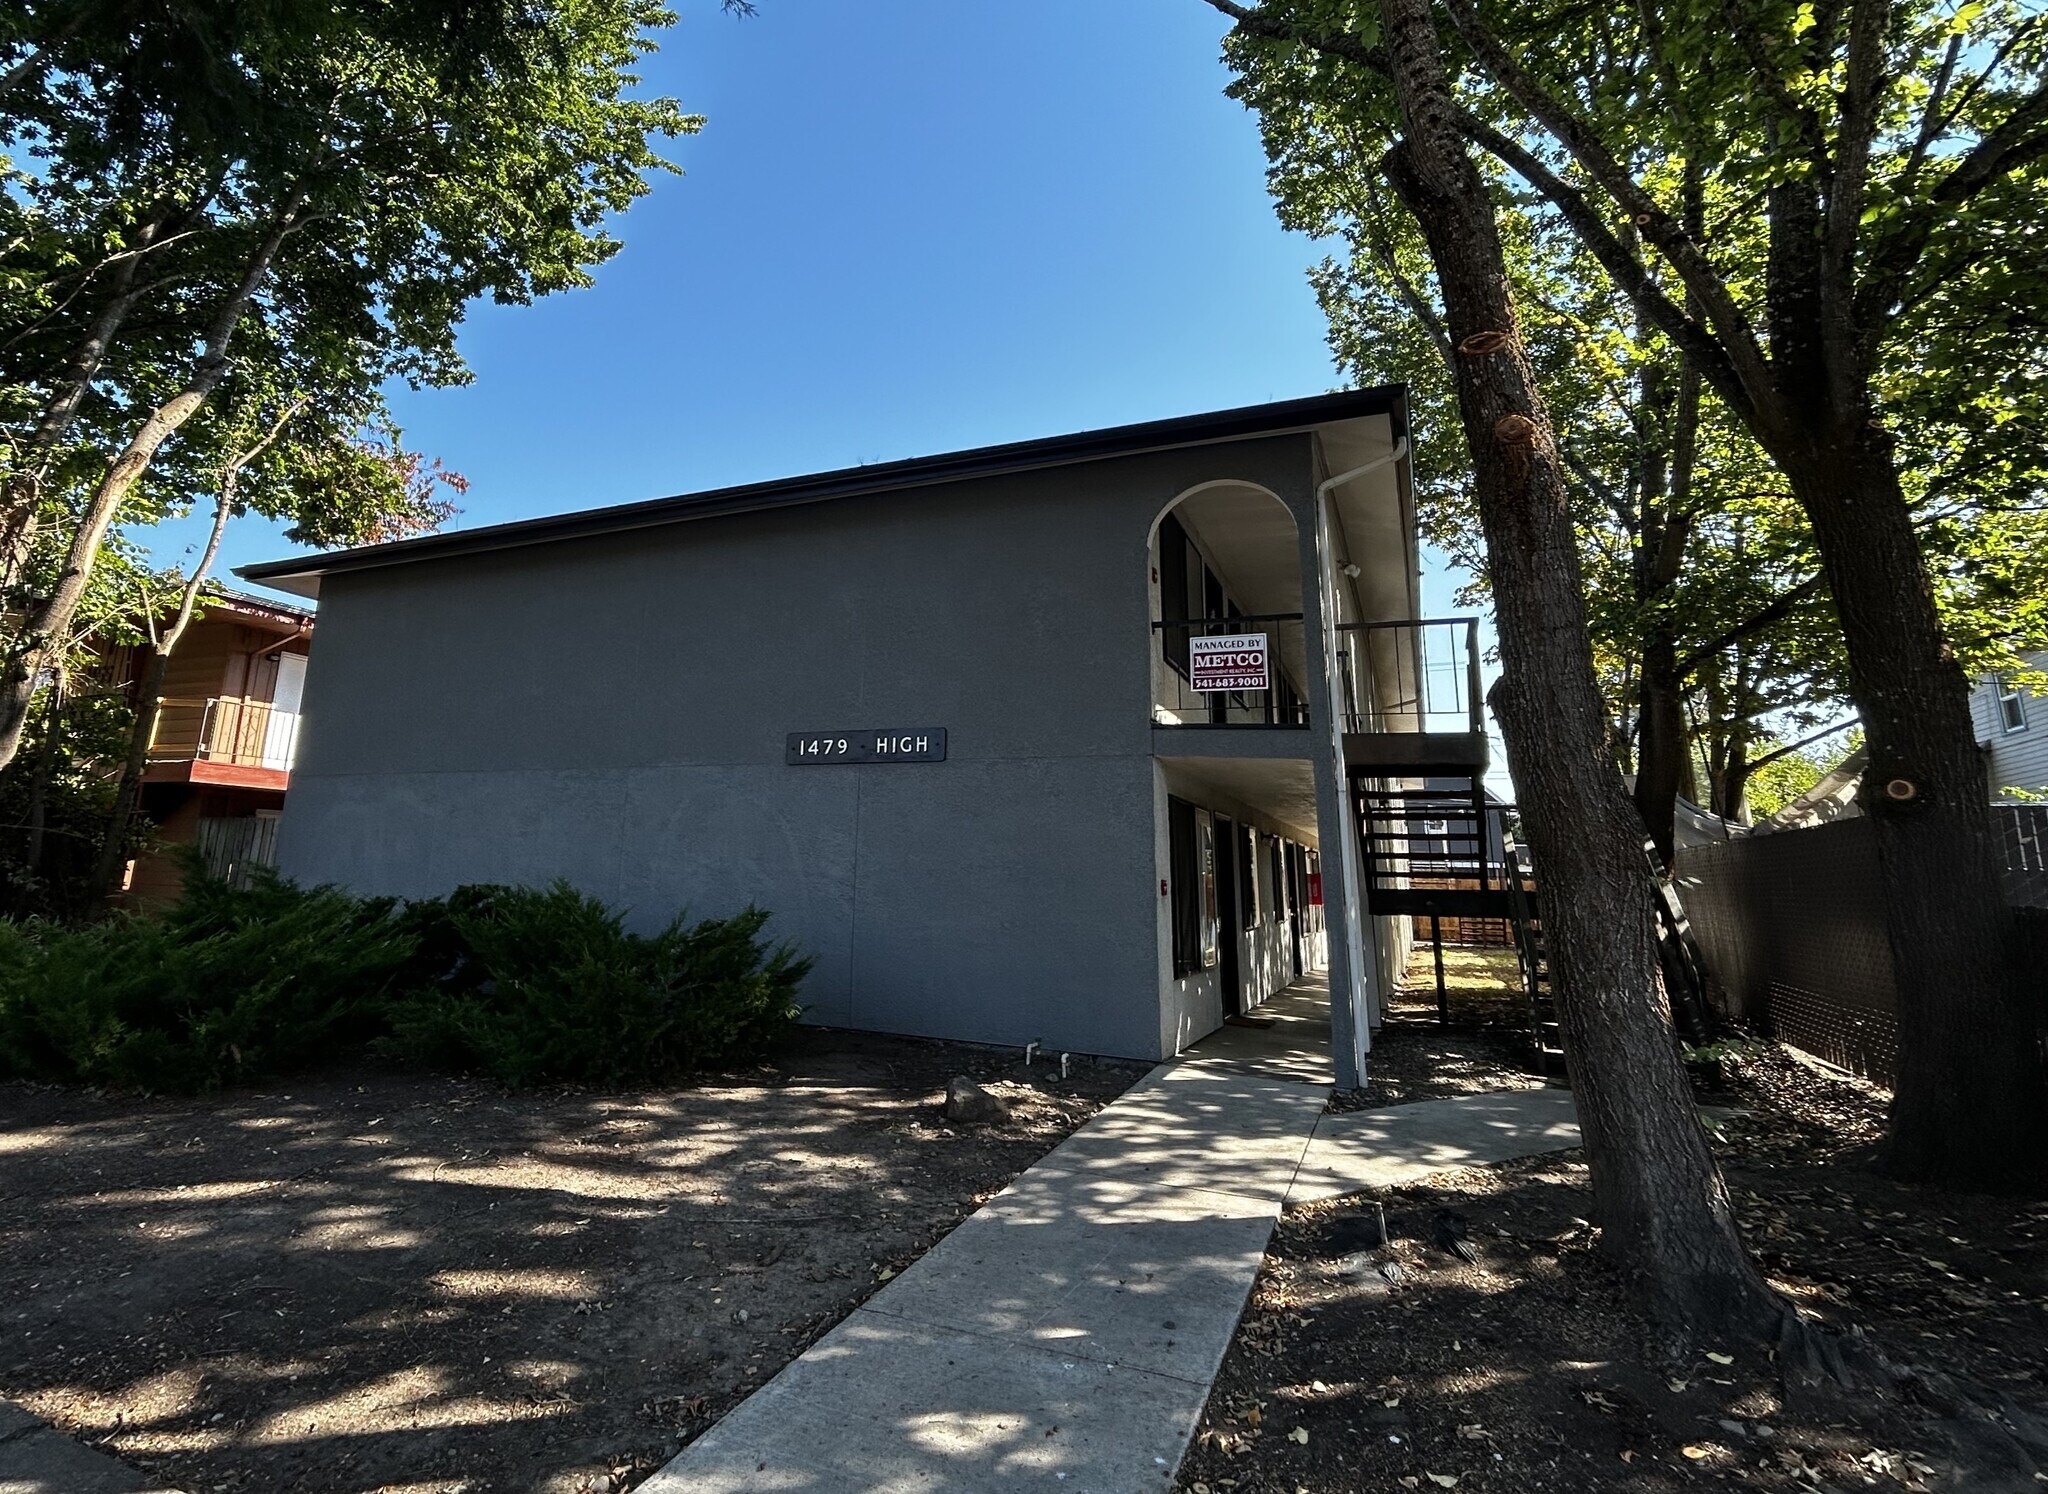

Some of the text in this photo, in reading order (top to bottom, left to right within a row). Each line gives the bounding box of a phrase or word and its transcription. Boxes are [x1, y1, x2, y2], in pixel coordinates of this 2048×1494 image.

[1195, 639, 1261, 650] MANAGED BY
[1194, 653, 1263, 668] METCO
[1195, 677, 1263, 688] 541-683-9001
[800, 736, 928, 755] 1479 HIGH
